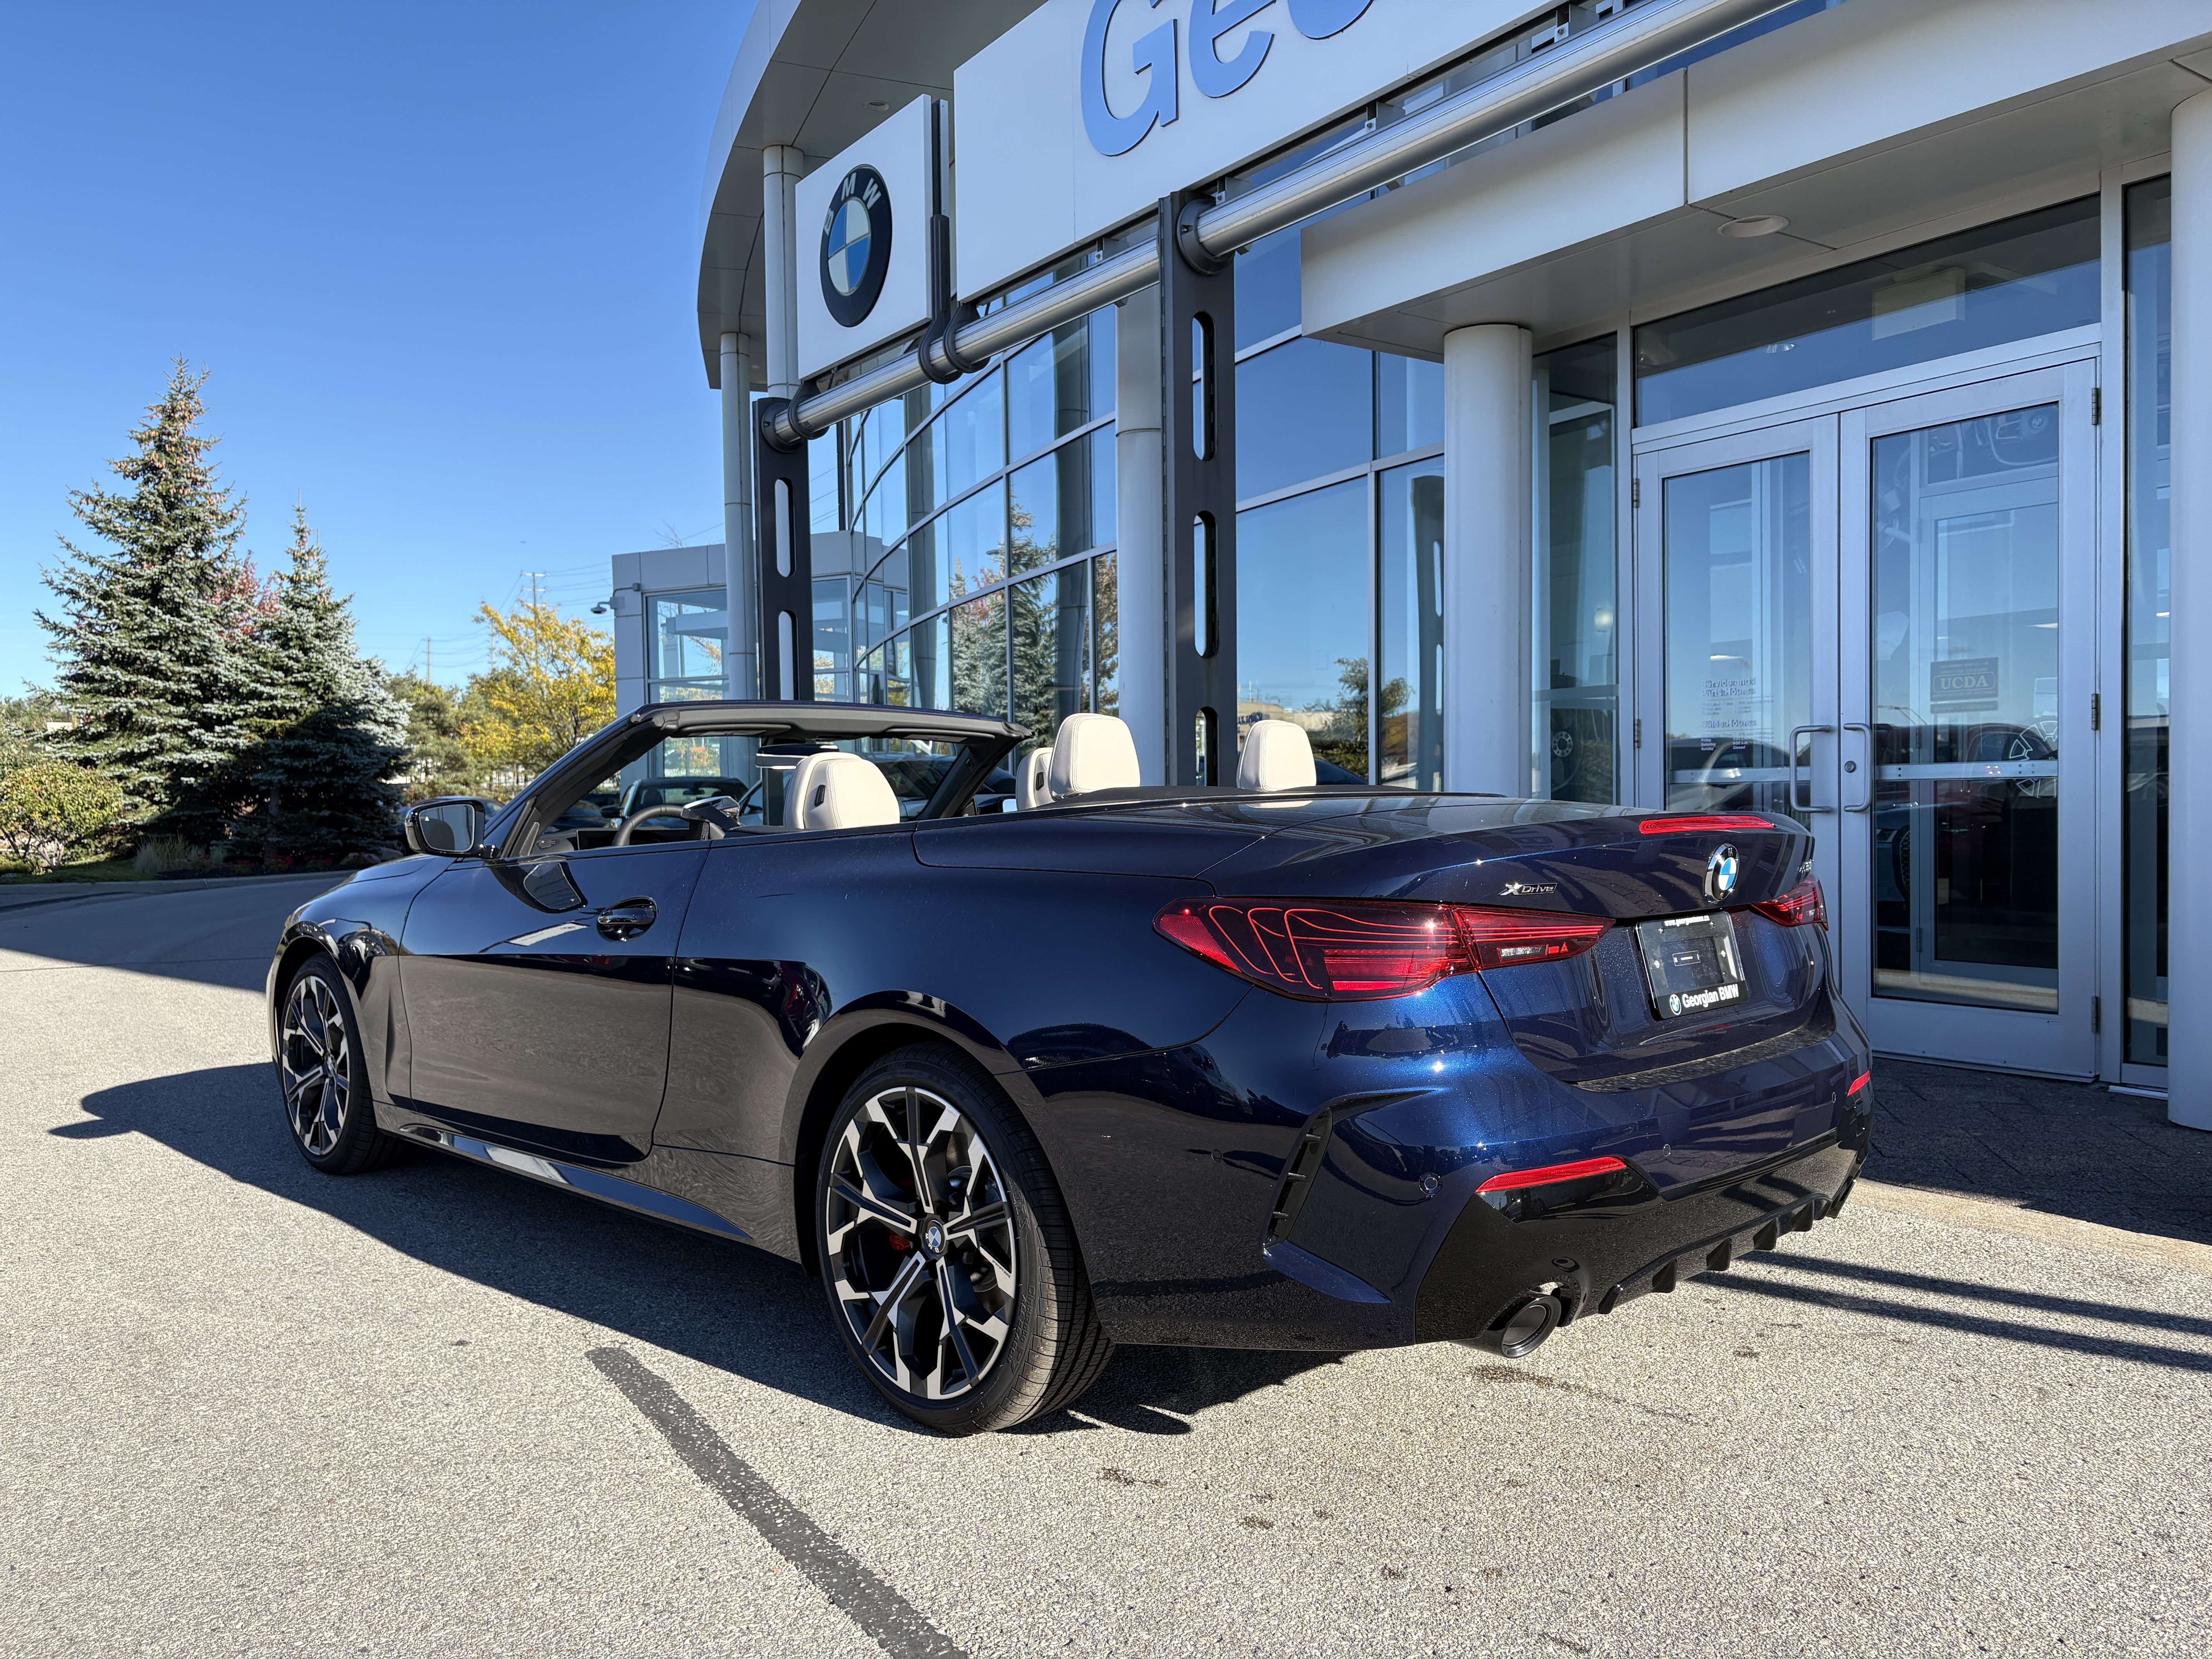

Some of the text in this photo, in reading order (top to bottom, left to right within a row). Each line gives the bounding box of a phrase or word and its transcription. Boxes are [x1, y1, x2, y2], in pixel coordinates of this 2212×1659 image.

[1941, 675, 1989, 689] UCDA
[1682, 989, 1719, 1008] Georgian
[1718, 984, 1739, 1000] BMW
